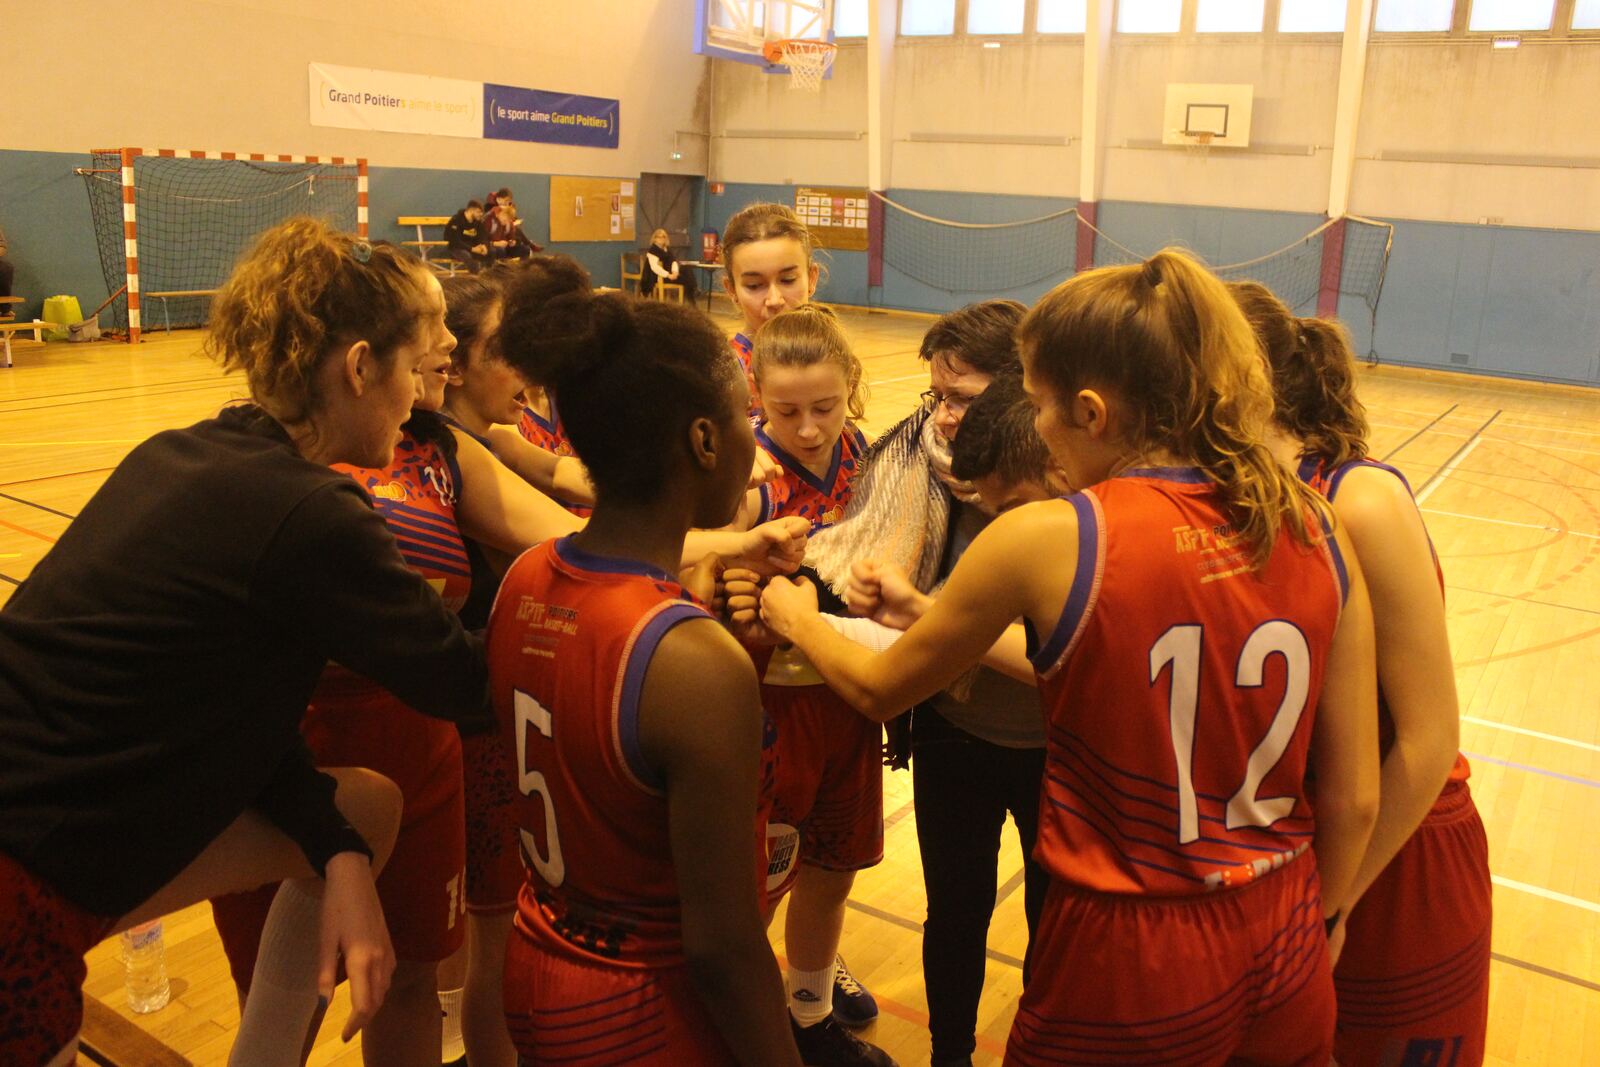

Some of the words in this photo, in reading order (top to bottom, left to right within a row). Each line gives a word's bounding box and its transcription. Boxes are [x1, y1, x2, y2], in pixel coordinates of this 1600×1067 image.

[328, 89, 361, 104] Grand
[363, 93, 407, 109] Poitiers
[409, 101, 432, 111] aime
[434, 100, 443, 112] le
[445, 102, 468, 114] sport
[497, 106, 506, 118] le
[507, 109, 529, 122] sport
[530, 110, 550, 123] aime
[551, 112, 575, 125] Grand
[576, 114, 608, 128] Poitiers
[513, 687, 566, 889] 5
[1149, 619, 1310, 845] 12
